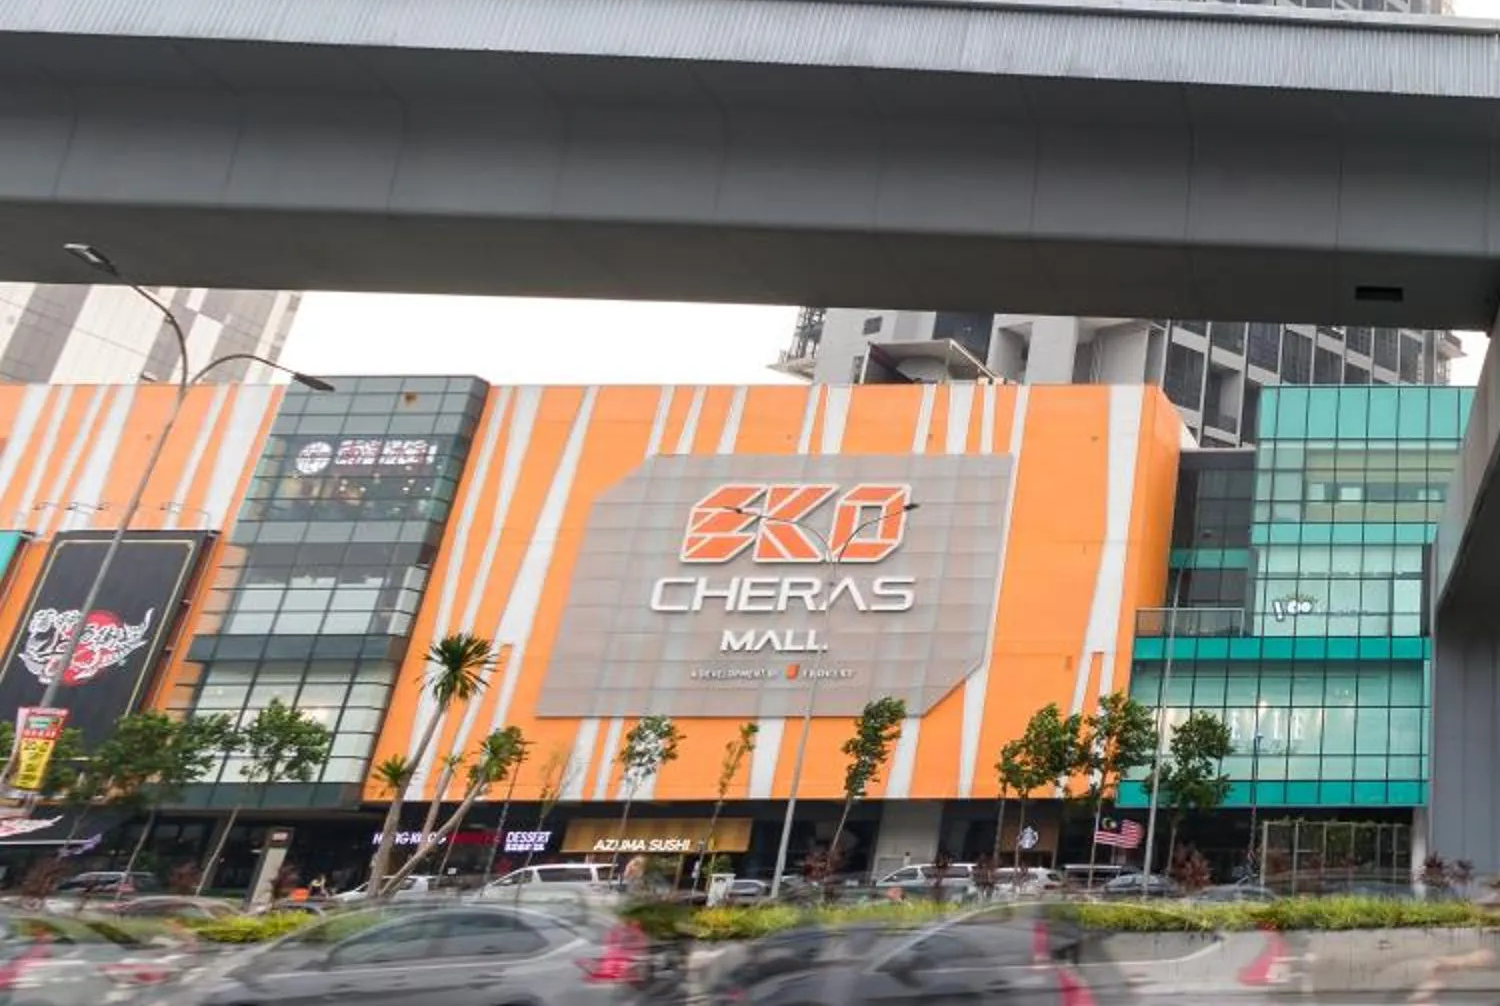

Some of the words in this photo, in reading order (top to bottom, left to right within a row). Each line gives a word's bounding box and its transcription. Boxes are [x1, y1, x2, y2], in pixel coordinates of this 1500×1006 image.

[680, 483, 912, 563] EKO
[651, 576, 916, 612] CHERAS
[719, 629, 829, 651] MALL
[506, 831, 552, 843] DESSERT
[593, 839, 646, 851] AZUMA
[649, 839, 691, 851] SUSHI
